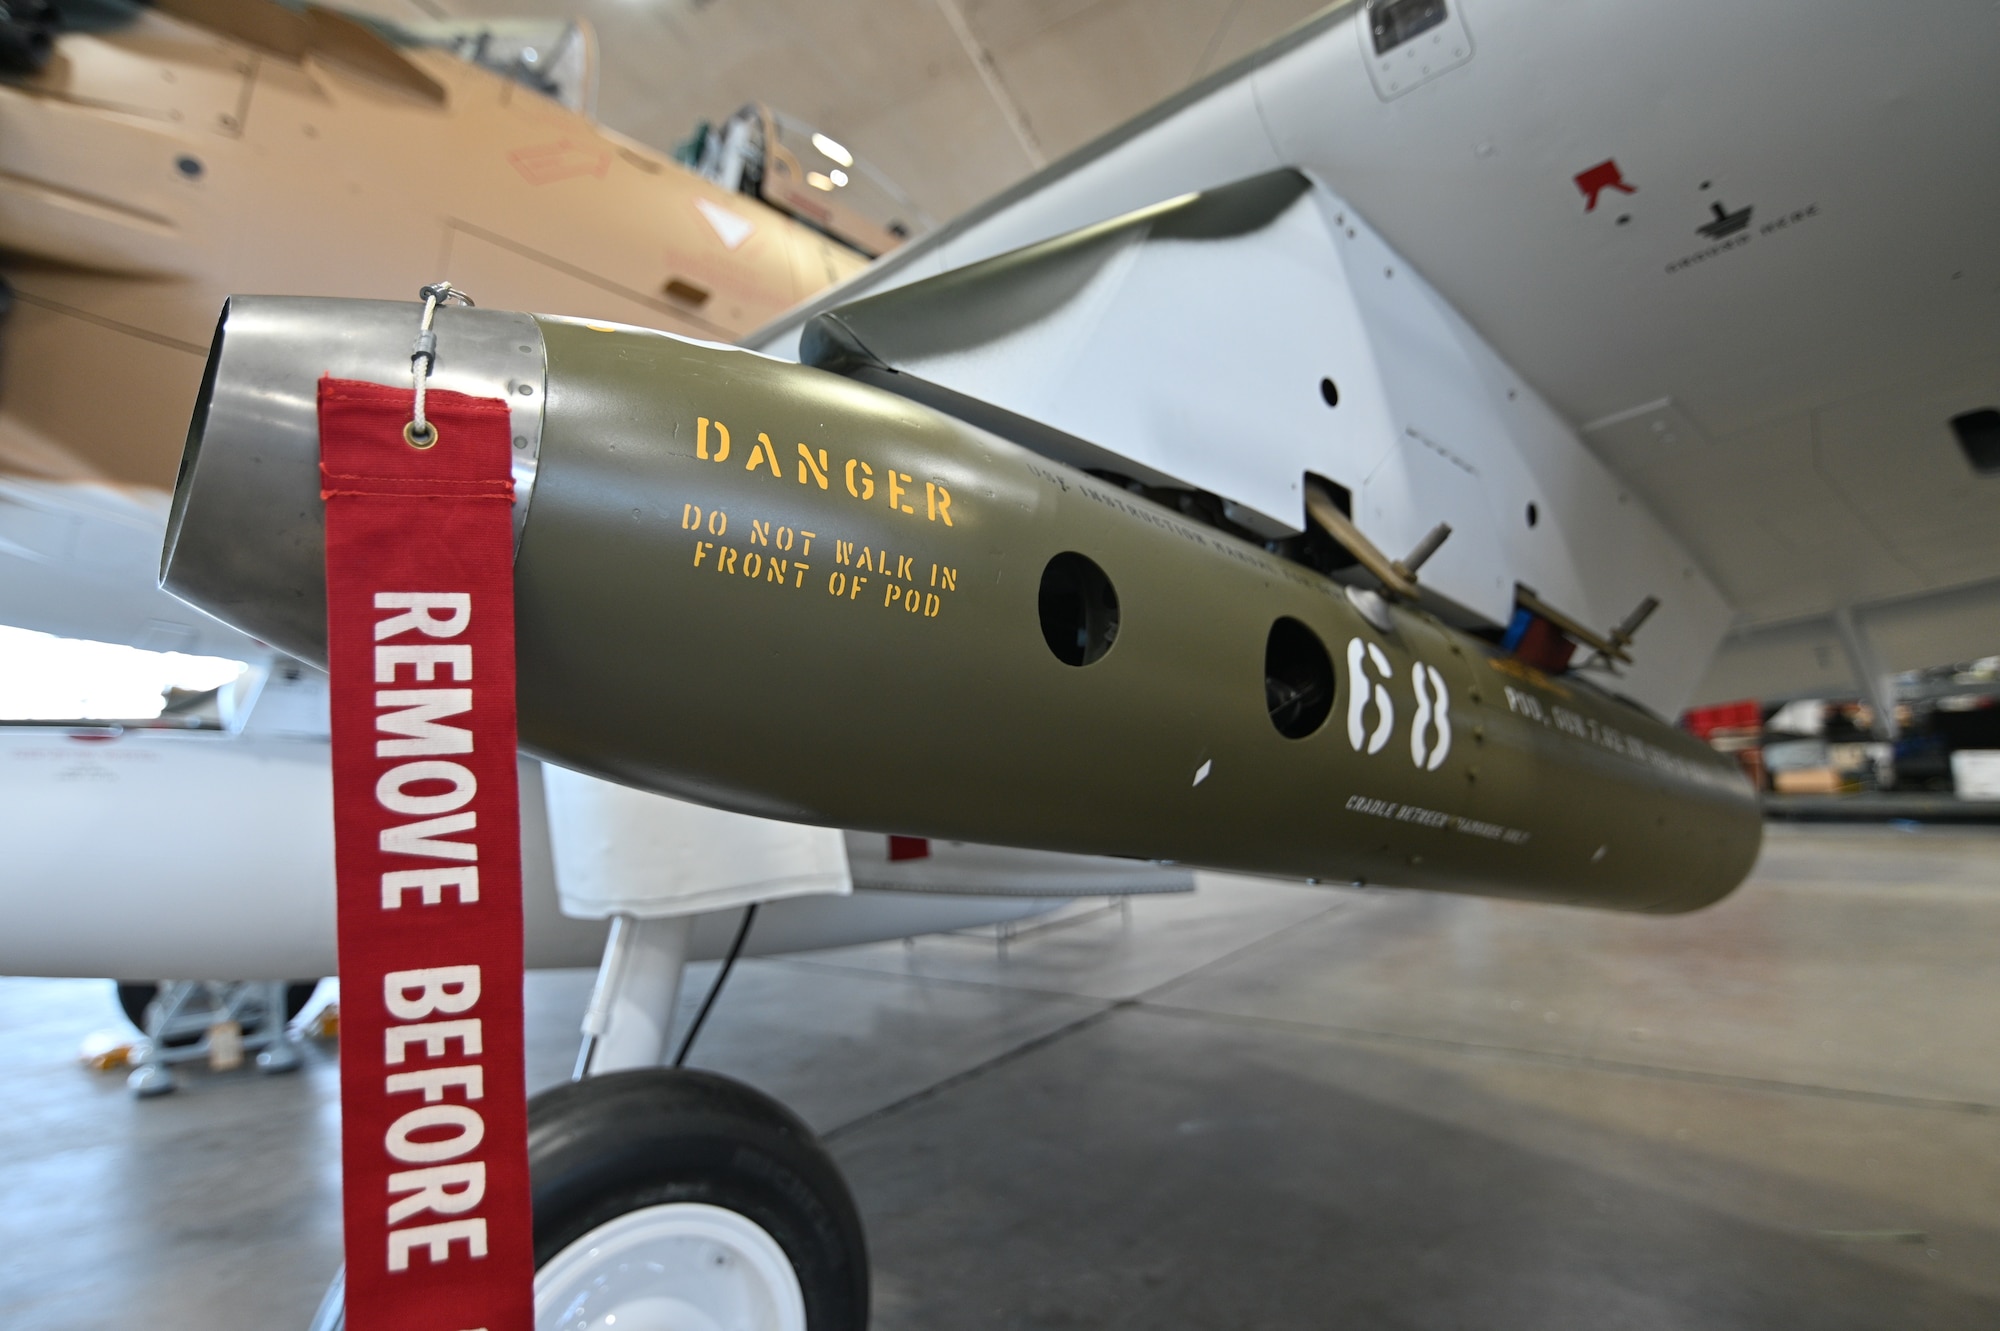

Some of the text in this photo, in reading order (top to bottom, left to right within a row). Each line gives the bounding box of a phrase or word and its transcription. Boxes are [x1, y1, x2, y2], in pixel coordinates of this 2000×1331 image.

[695, 416, 955, 528] DANGER
[682, 503, 957, 592] DO NOT WALK IN
[693, 540, 941, 618] FRONT OF POD
[1347, 636, 1452, 771] 68
[1345, 794, 1398, 818] CRADLE
[1395, 804, 1450, 828] BETWEEN
[373, 591, 488, 1272] REMOVE BEFORE
